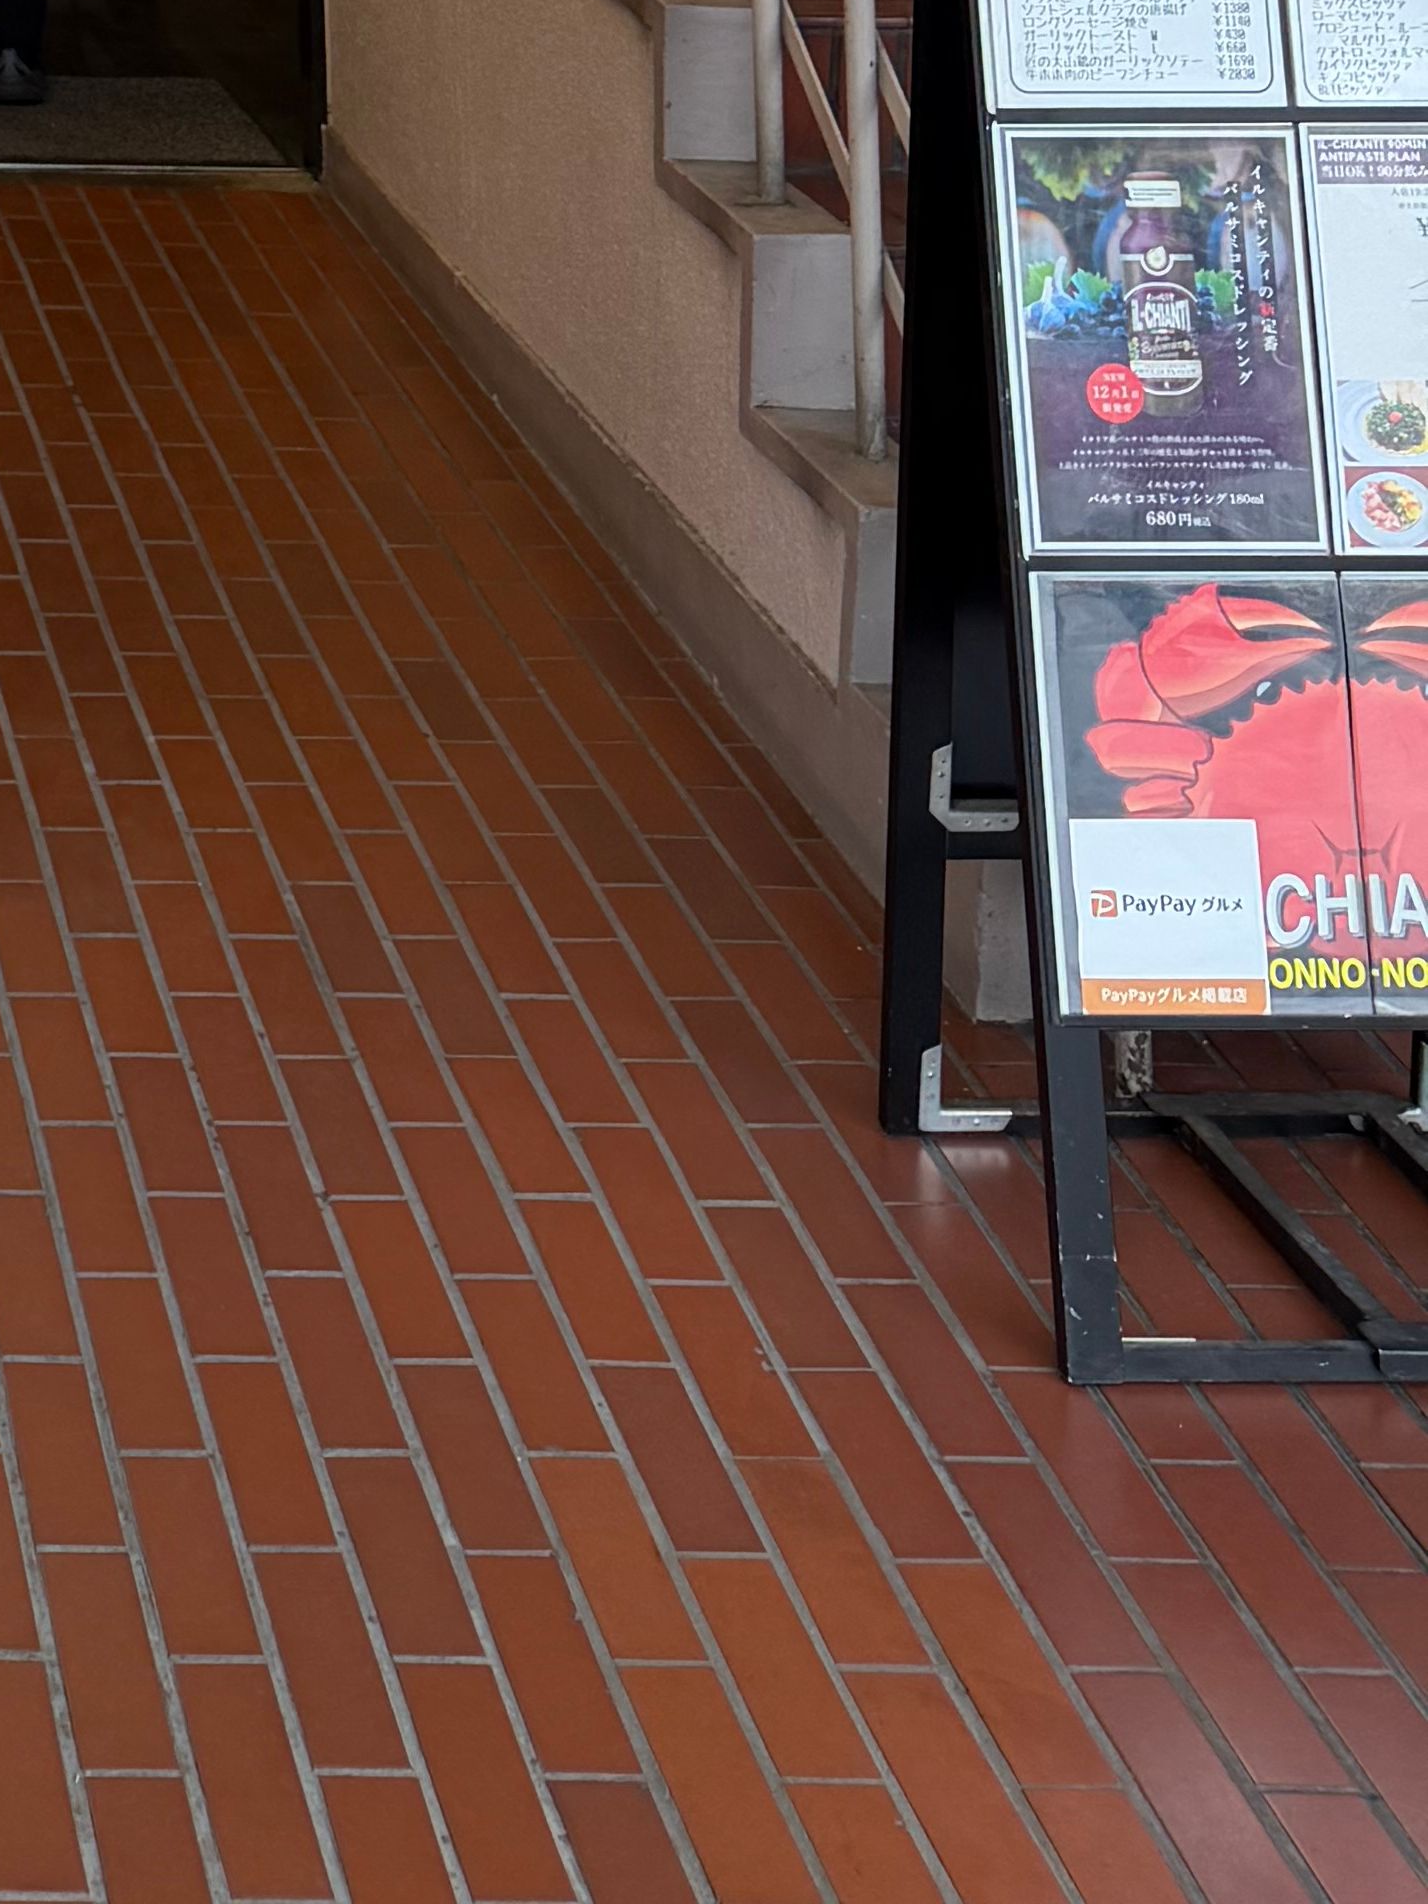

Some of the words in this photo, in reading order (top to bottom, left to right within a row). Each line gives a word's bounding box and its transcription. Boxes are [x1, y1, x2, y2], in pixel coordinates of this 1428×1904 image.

[1318, 151, 1386, 162] ANTIPASTI
[1122, 893, 1197, 917] PayPay
[1202, 894, 1245, 914] グルメ
